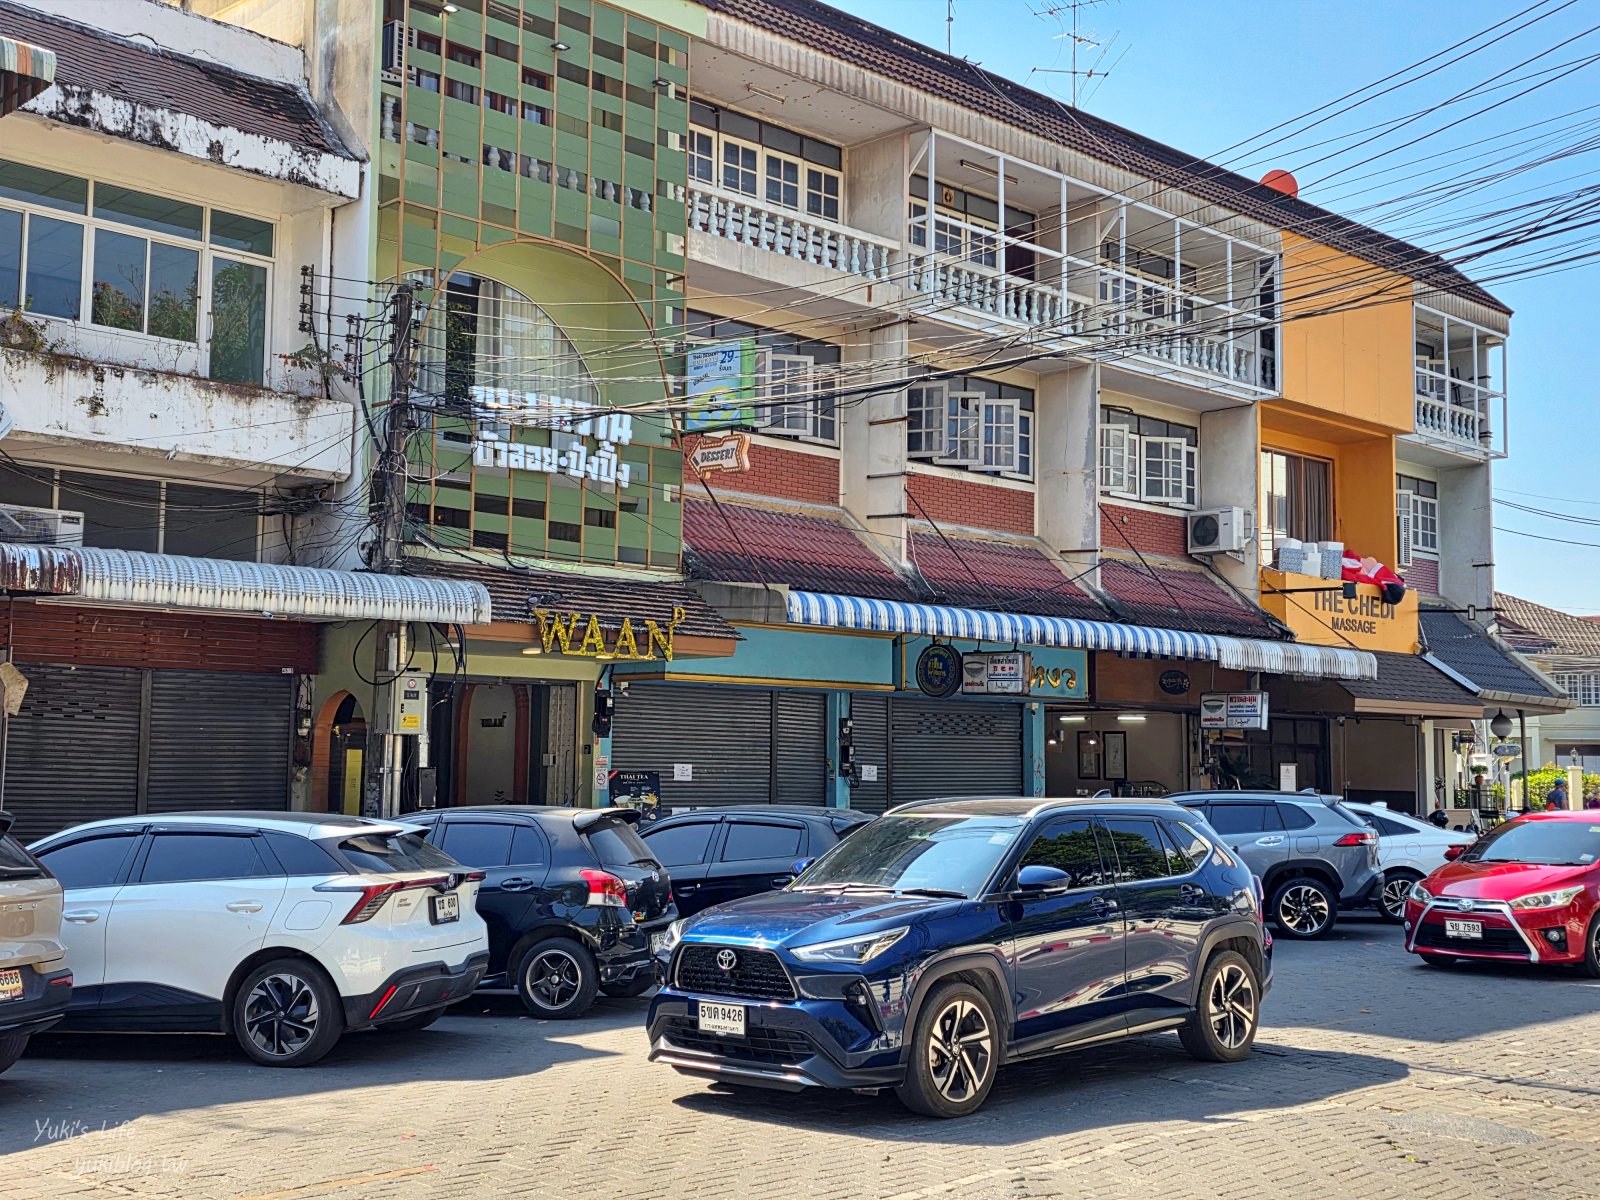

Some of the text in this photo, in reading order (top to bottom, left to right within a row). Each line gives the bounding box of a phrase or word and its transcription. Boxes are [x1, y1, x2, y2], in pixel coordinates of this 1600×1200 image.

[700, 447, 736, 463] DESSERT
[1314, 590, 1396, 620] THE CHEDI
[1331, 617, 1377, 635] MASSAGE
[1463, 923, 1480, 931] 7593
[721, 1007, 742, 1022] 9426
